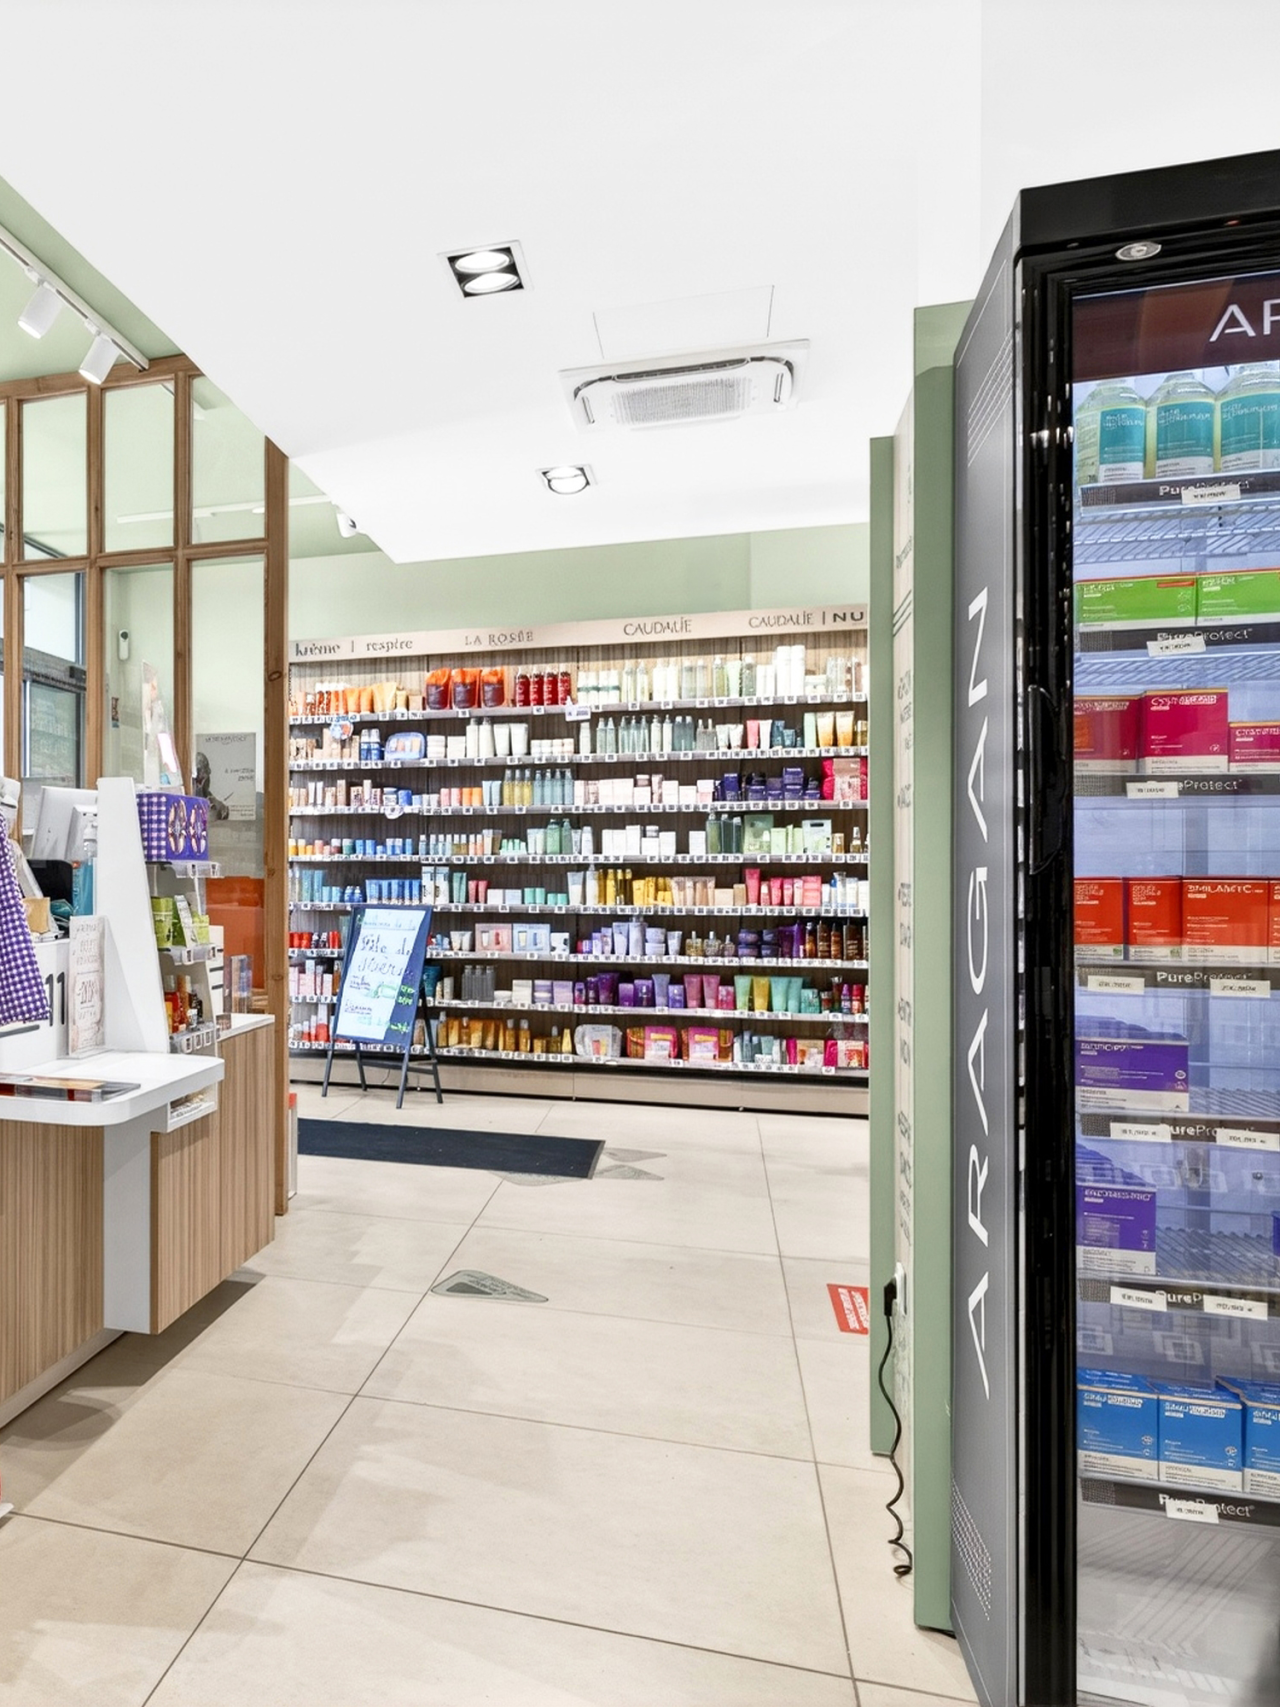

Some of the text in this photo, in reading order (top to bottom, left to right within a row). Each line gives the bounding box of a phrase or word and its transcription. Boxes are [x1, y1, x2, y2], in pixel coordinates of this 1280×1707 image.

[623, 616, 692, 637] CAUDALIE
[748, 609, 814, 628] CAUDALIE
[464, 635, 483, 646] LA
[967, 585, 989, 1401] ARAGAN
